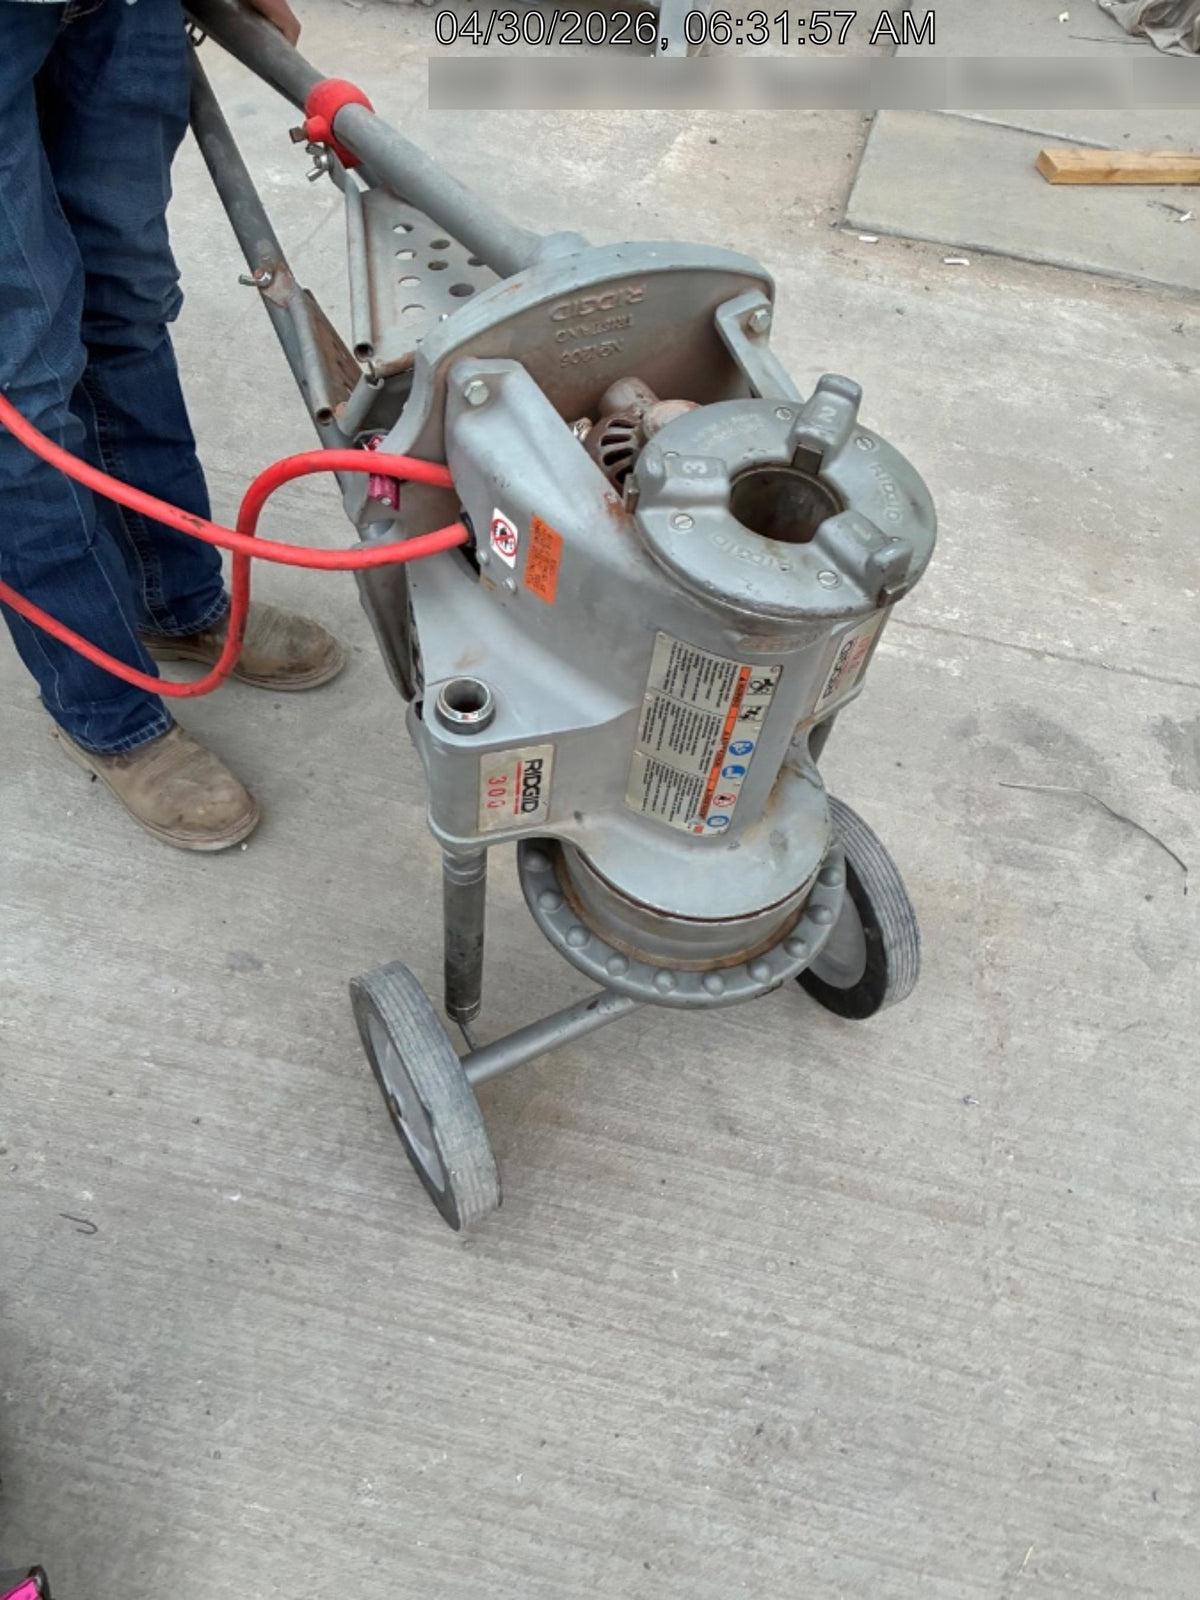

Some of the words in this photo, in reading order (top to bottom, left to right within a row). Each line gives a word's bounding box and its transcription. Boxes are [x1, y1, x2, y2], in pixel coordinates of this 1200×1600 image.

[817, 405, 837, 423] 2
[682, 459, 707, 475] 3
[486, 775, 507, 809] 300
[521, 758, 544, 813] RIDGID
